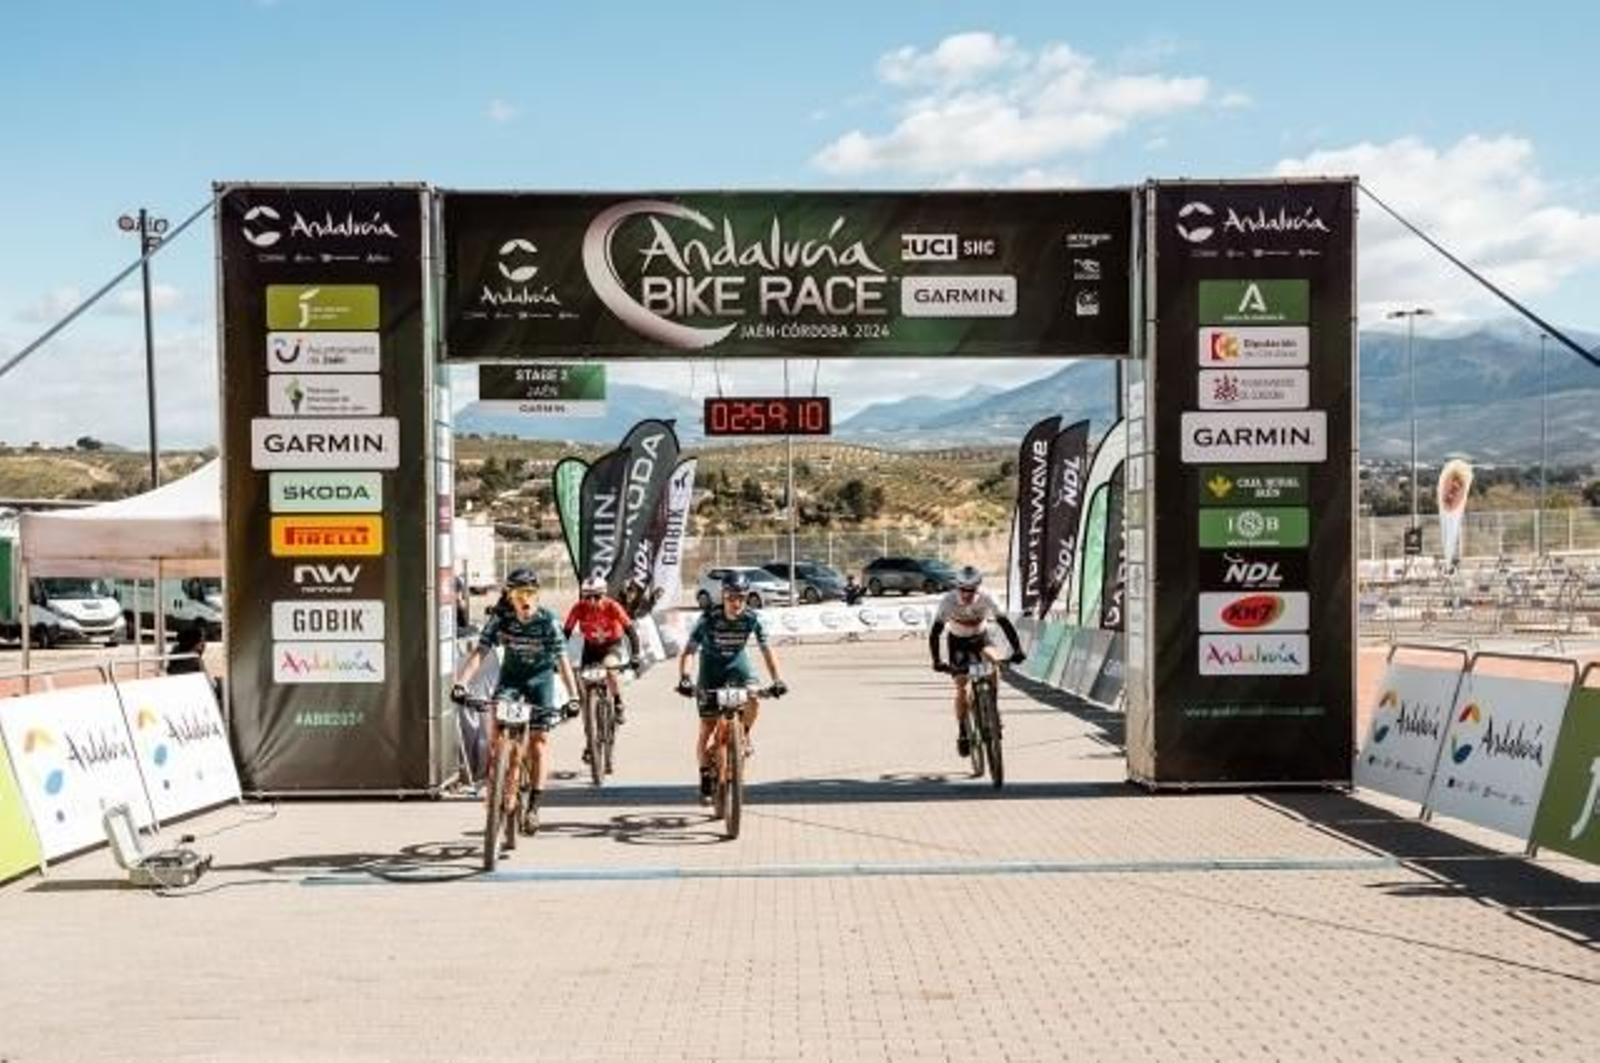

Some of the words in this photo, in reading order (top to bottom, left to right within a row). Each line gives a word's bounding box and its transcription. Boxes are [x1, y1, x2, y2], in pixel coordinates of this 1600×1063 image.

[639, 214, 884, 275] Andalucía
[911, 239, 953, 255] UCI
[643, 276, 745, 316] BIKE
[759, 276, 887, 316] RACE
[913, 288, 1005, 303] GARMIN
[263, 434, 383, 453] GARMIN
[1193, 427, 1312, 447] GARMIN
[1223, 562, 1283, 582] NDL
[293, 608, 364, 633] GOBIK
